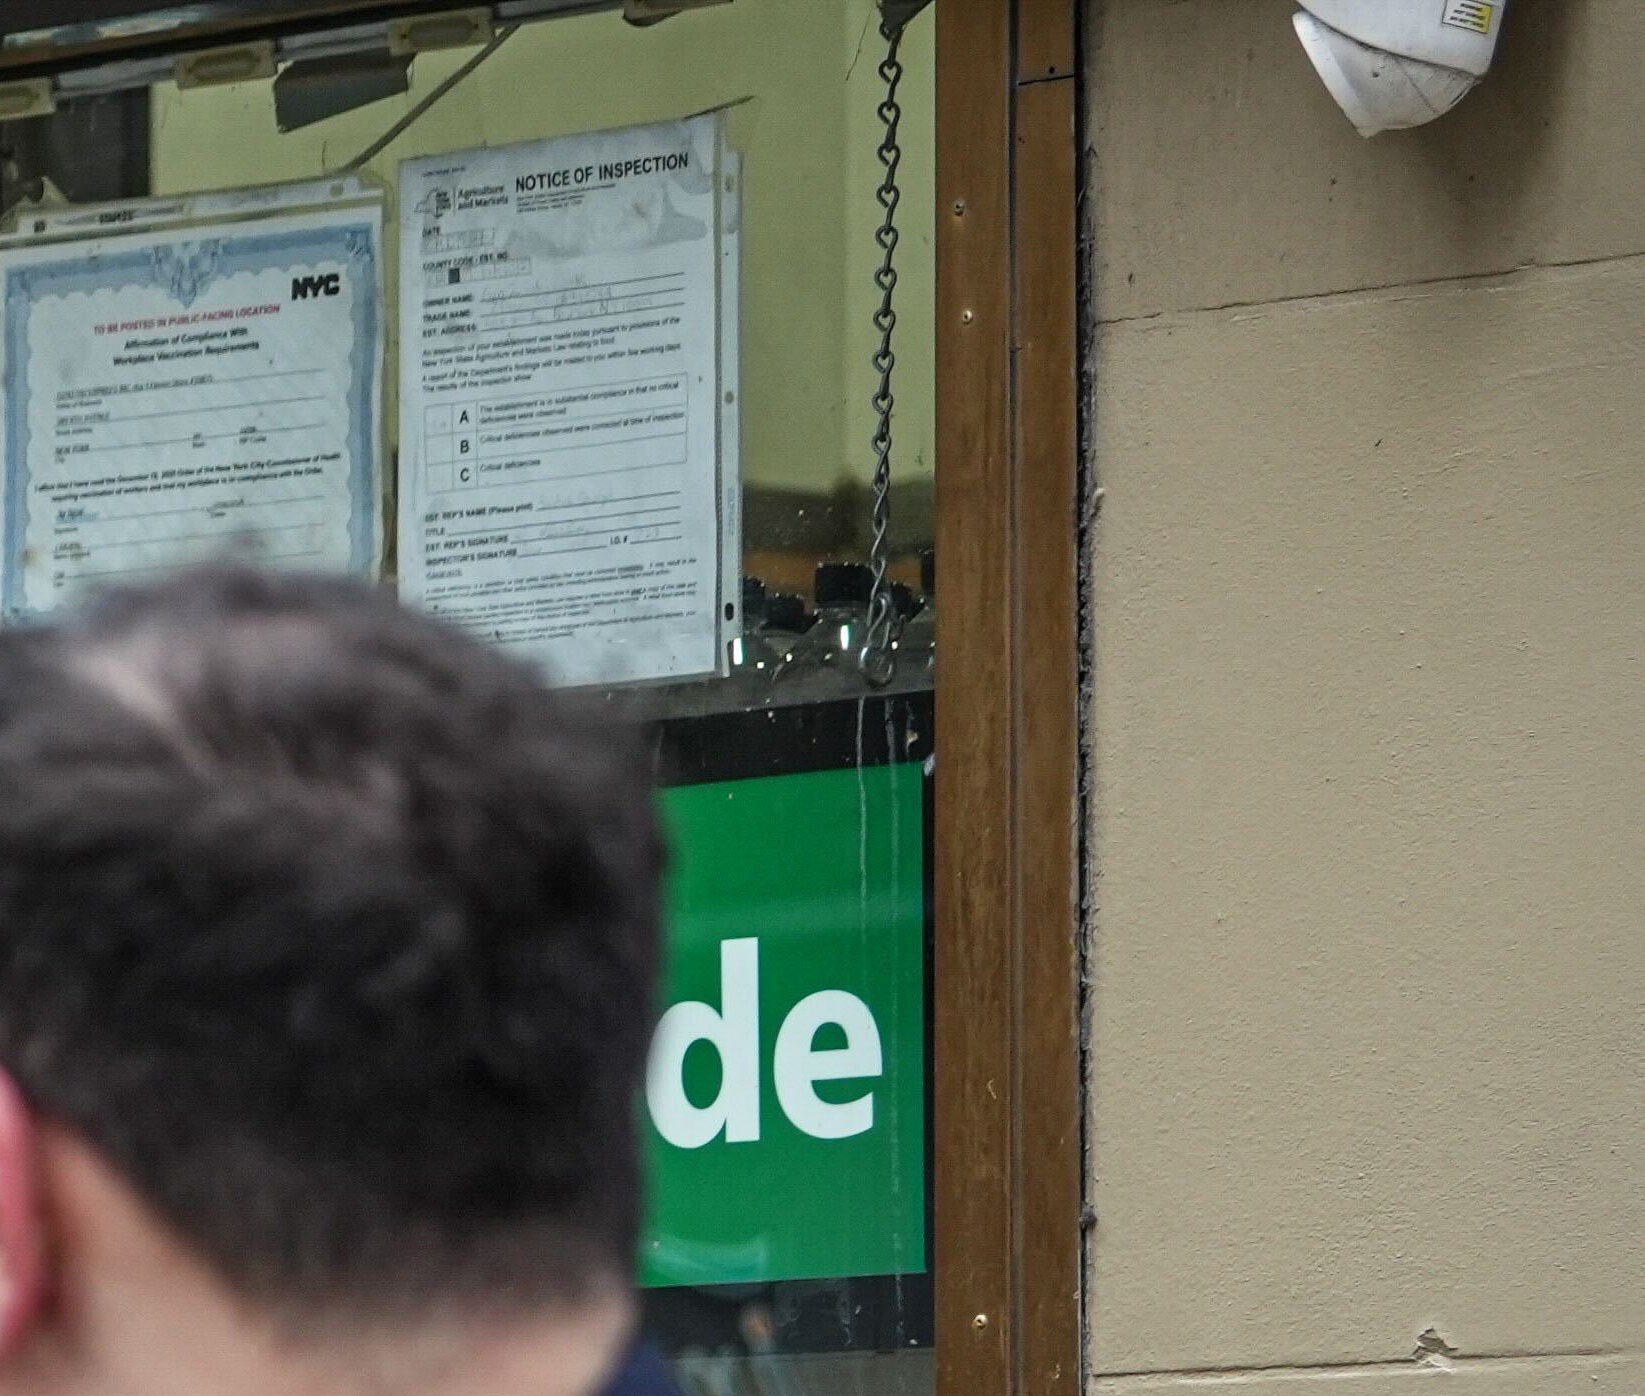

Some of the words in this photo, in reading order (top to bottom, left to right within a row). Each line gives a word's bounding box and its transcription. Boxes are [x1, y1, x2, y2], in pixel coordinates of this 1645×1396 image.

[516, 170, 570, 193] NOTICE
[574, 165, 593, 184] OF
[598, 151, 689, 181] INSPECTION
[457, 184, 505, 200] Agriculture
[457, 199, 474, 211] and
[474, 194, 509, 208] Markets
[291, 272, 341, 301] NYC
[93, 325, 105, 336] TO
[119, 319, 155, 333] POSTED
[167, 310, 234, 328] PUBLIC-FACING
[234, 303, 282, 319] LOCATION
[180, 329, 229, 346] Compliance
[156, 347, 204, 363] Vaccination
[203, 340, 260, 357] Requirements
[459, 410, 470, 424] A
[459, 439, 470, 454] B
[459, 467, 470, 483] C
[645, 936, 883, 1150] de
